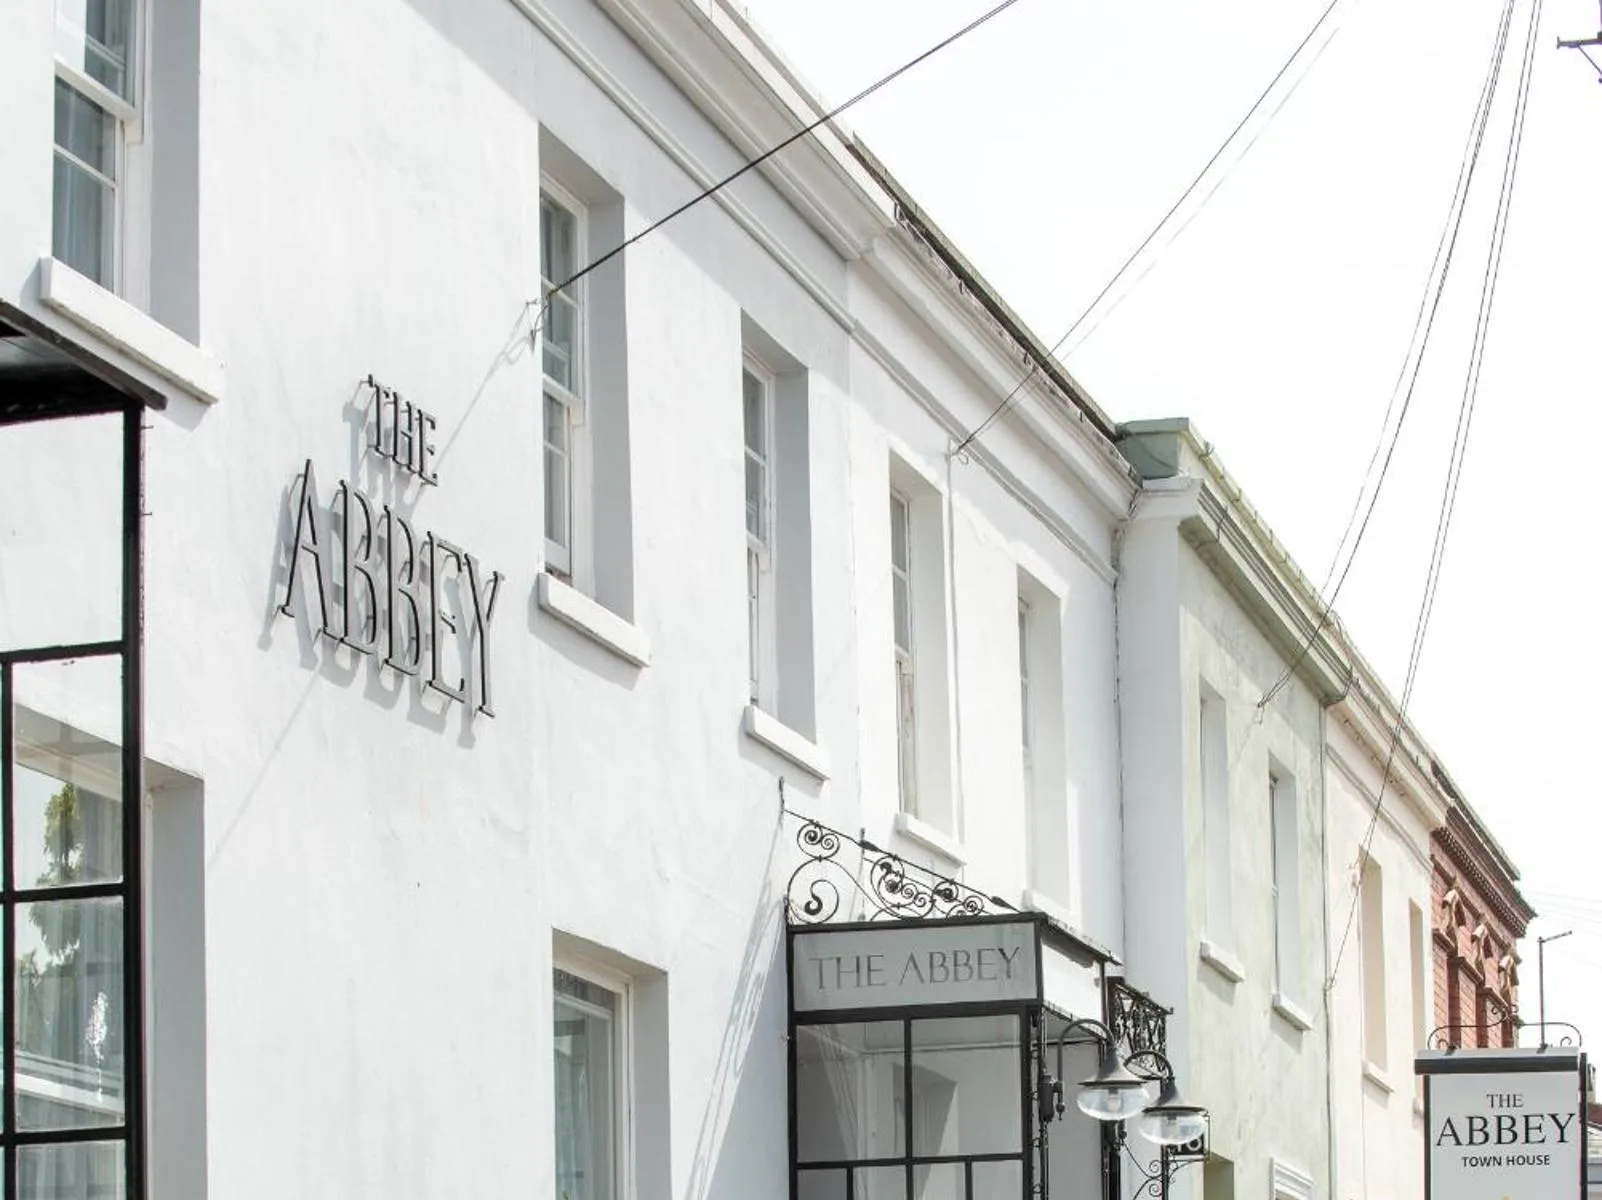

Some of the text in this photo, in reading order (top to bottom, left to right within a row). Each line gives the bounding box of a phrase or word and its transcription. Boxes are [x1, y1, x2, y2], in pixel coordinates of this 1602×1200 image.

[366, 374, 438, 486] THE
[279, 458, 503, 718] ABBEY
[808, 946, 1020, 990] THE ABBEY
[1485, 1093, 1524, 1108] THE
[1436, 1112, 1576, 1146] ABBEY
[1462, 1154, 1550, 1167] TOWN HOUSE
